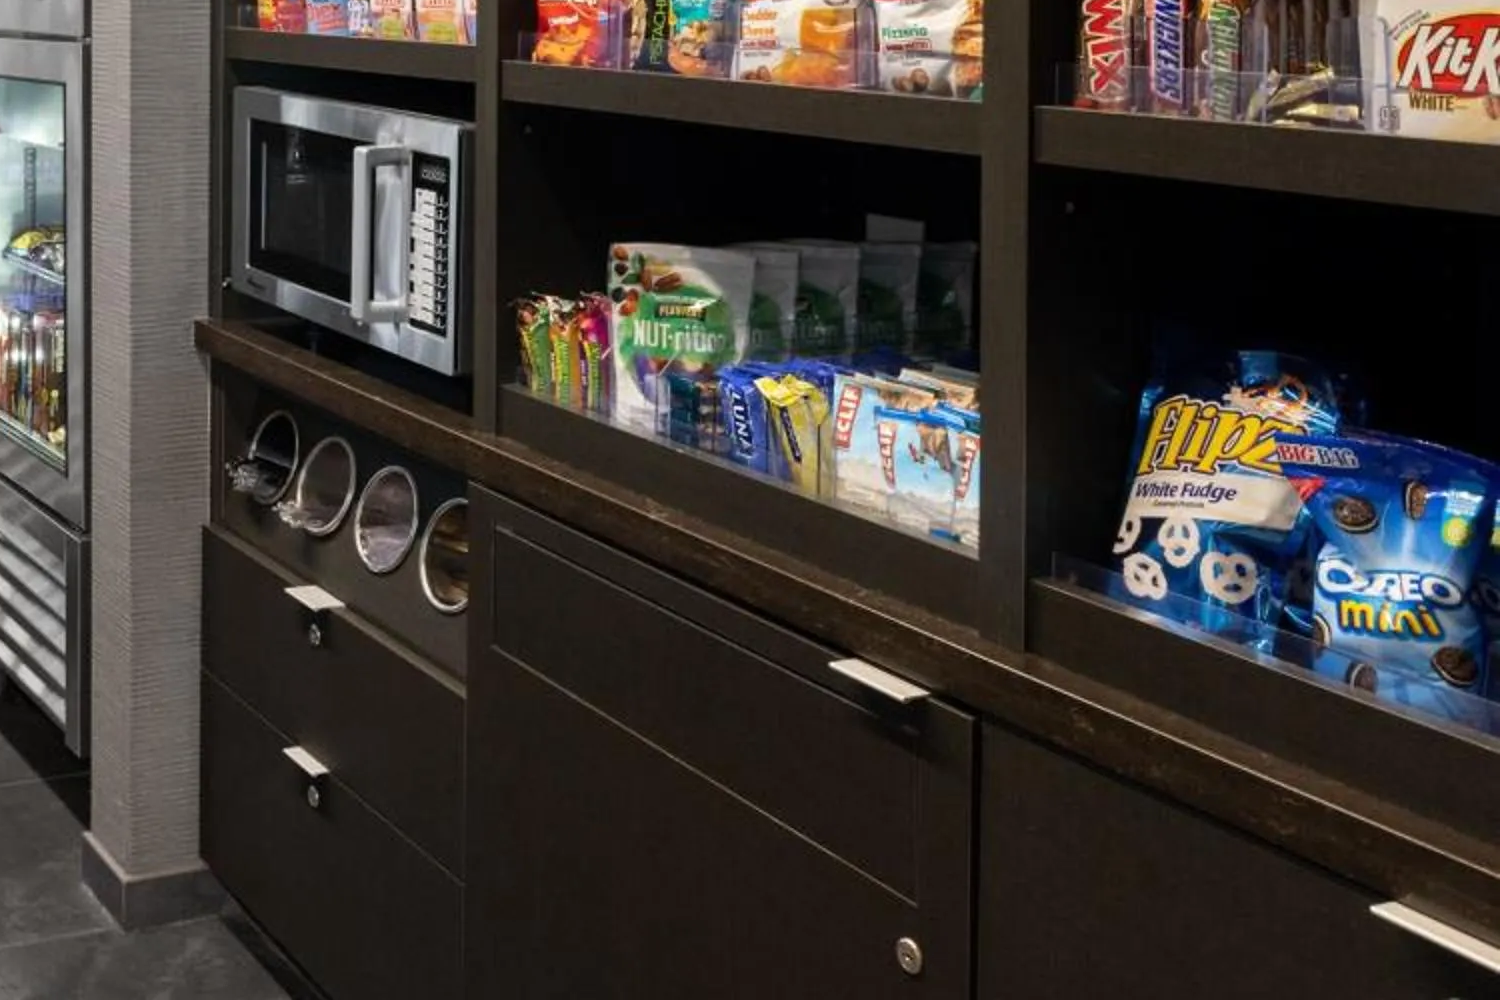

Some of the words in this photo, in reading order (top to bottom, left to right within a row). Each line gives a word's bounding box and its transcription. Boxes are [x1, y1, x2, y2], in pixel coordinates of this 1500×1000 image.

[1409, 91, 1456, 112] WHITE
[732, 390, 753, 450] LUNA
[1278, 443, 1316, 463] BIG
[1316, 447, 1361, 470] BAG
[1135, 480, 1179, 499] White
[1181, 481, 1238, 504] Fudge
[1316, 558, 1463, 605] OREO
[1339, 598, 1444, 638] mini
